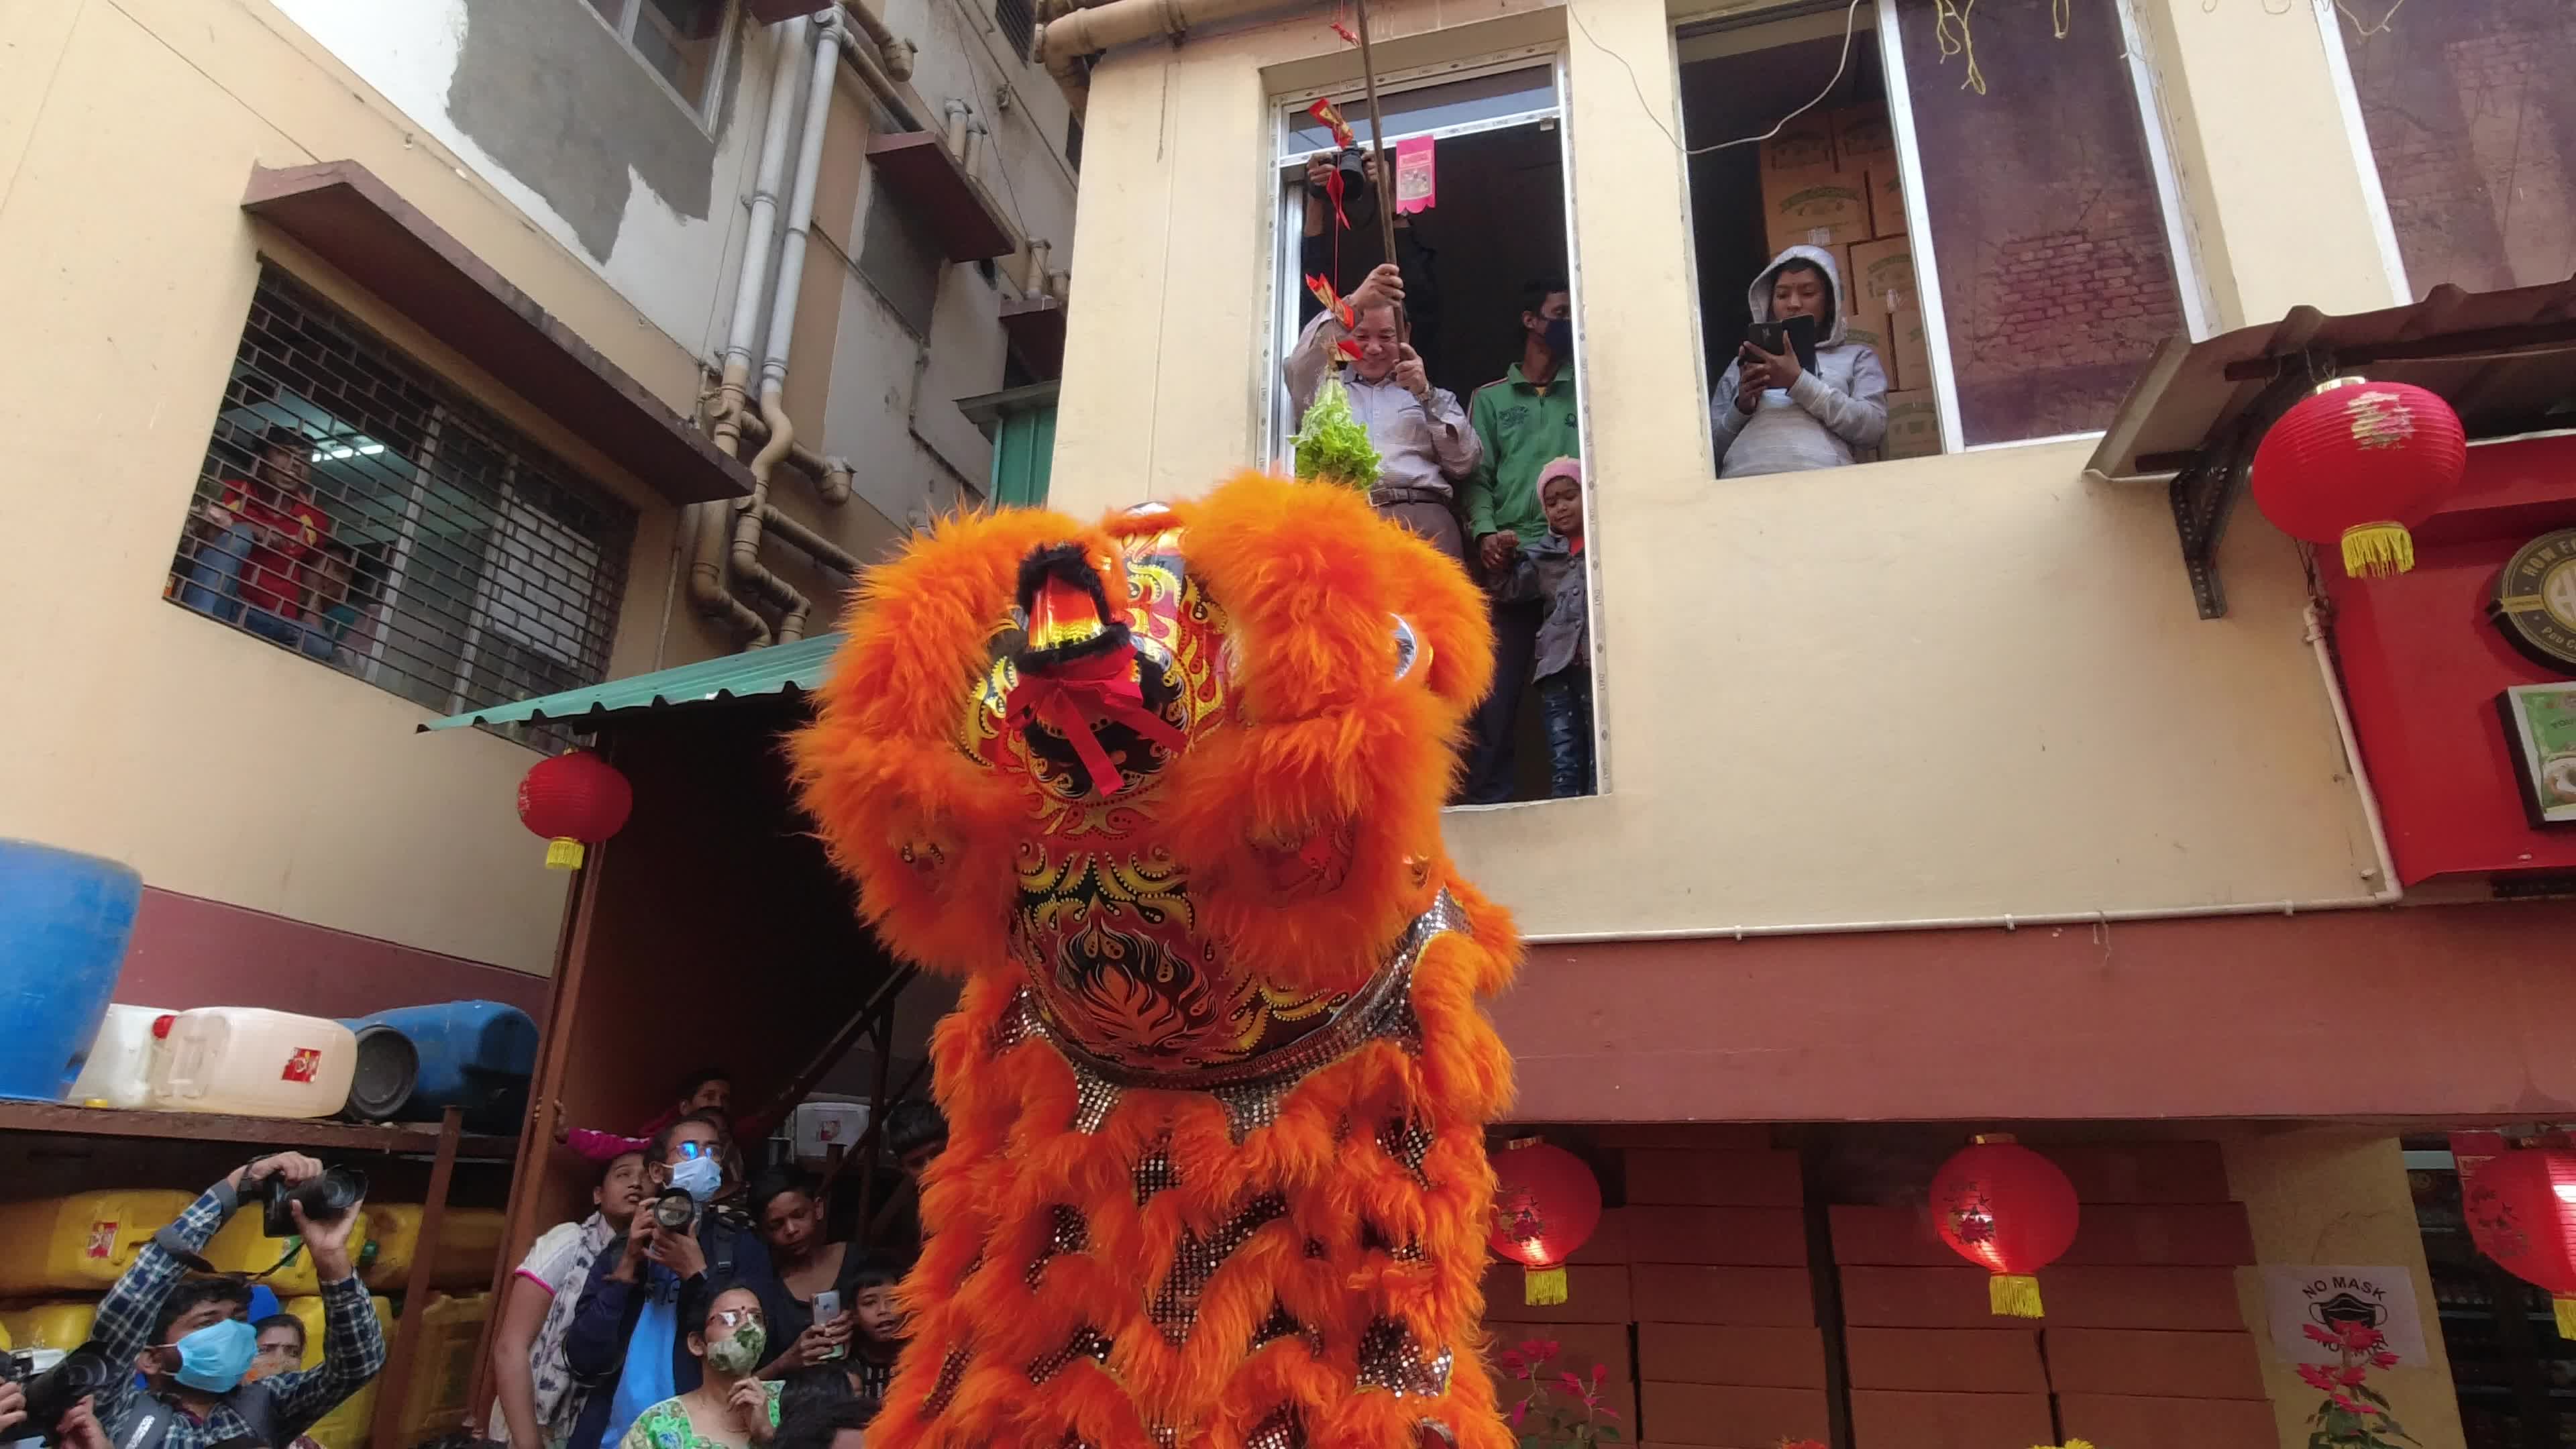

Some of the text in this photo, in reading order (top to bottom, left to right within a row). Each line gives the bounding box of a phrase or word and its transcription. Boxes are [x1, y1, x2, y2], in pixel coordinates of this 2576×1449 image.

[2522, 547, 2557, 578] HOW
[2302, 1277, 2387, 1301] NO MASK
